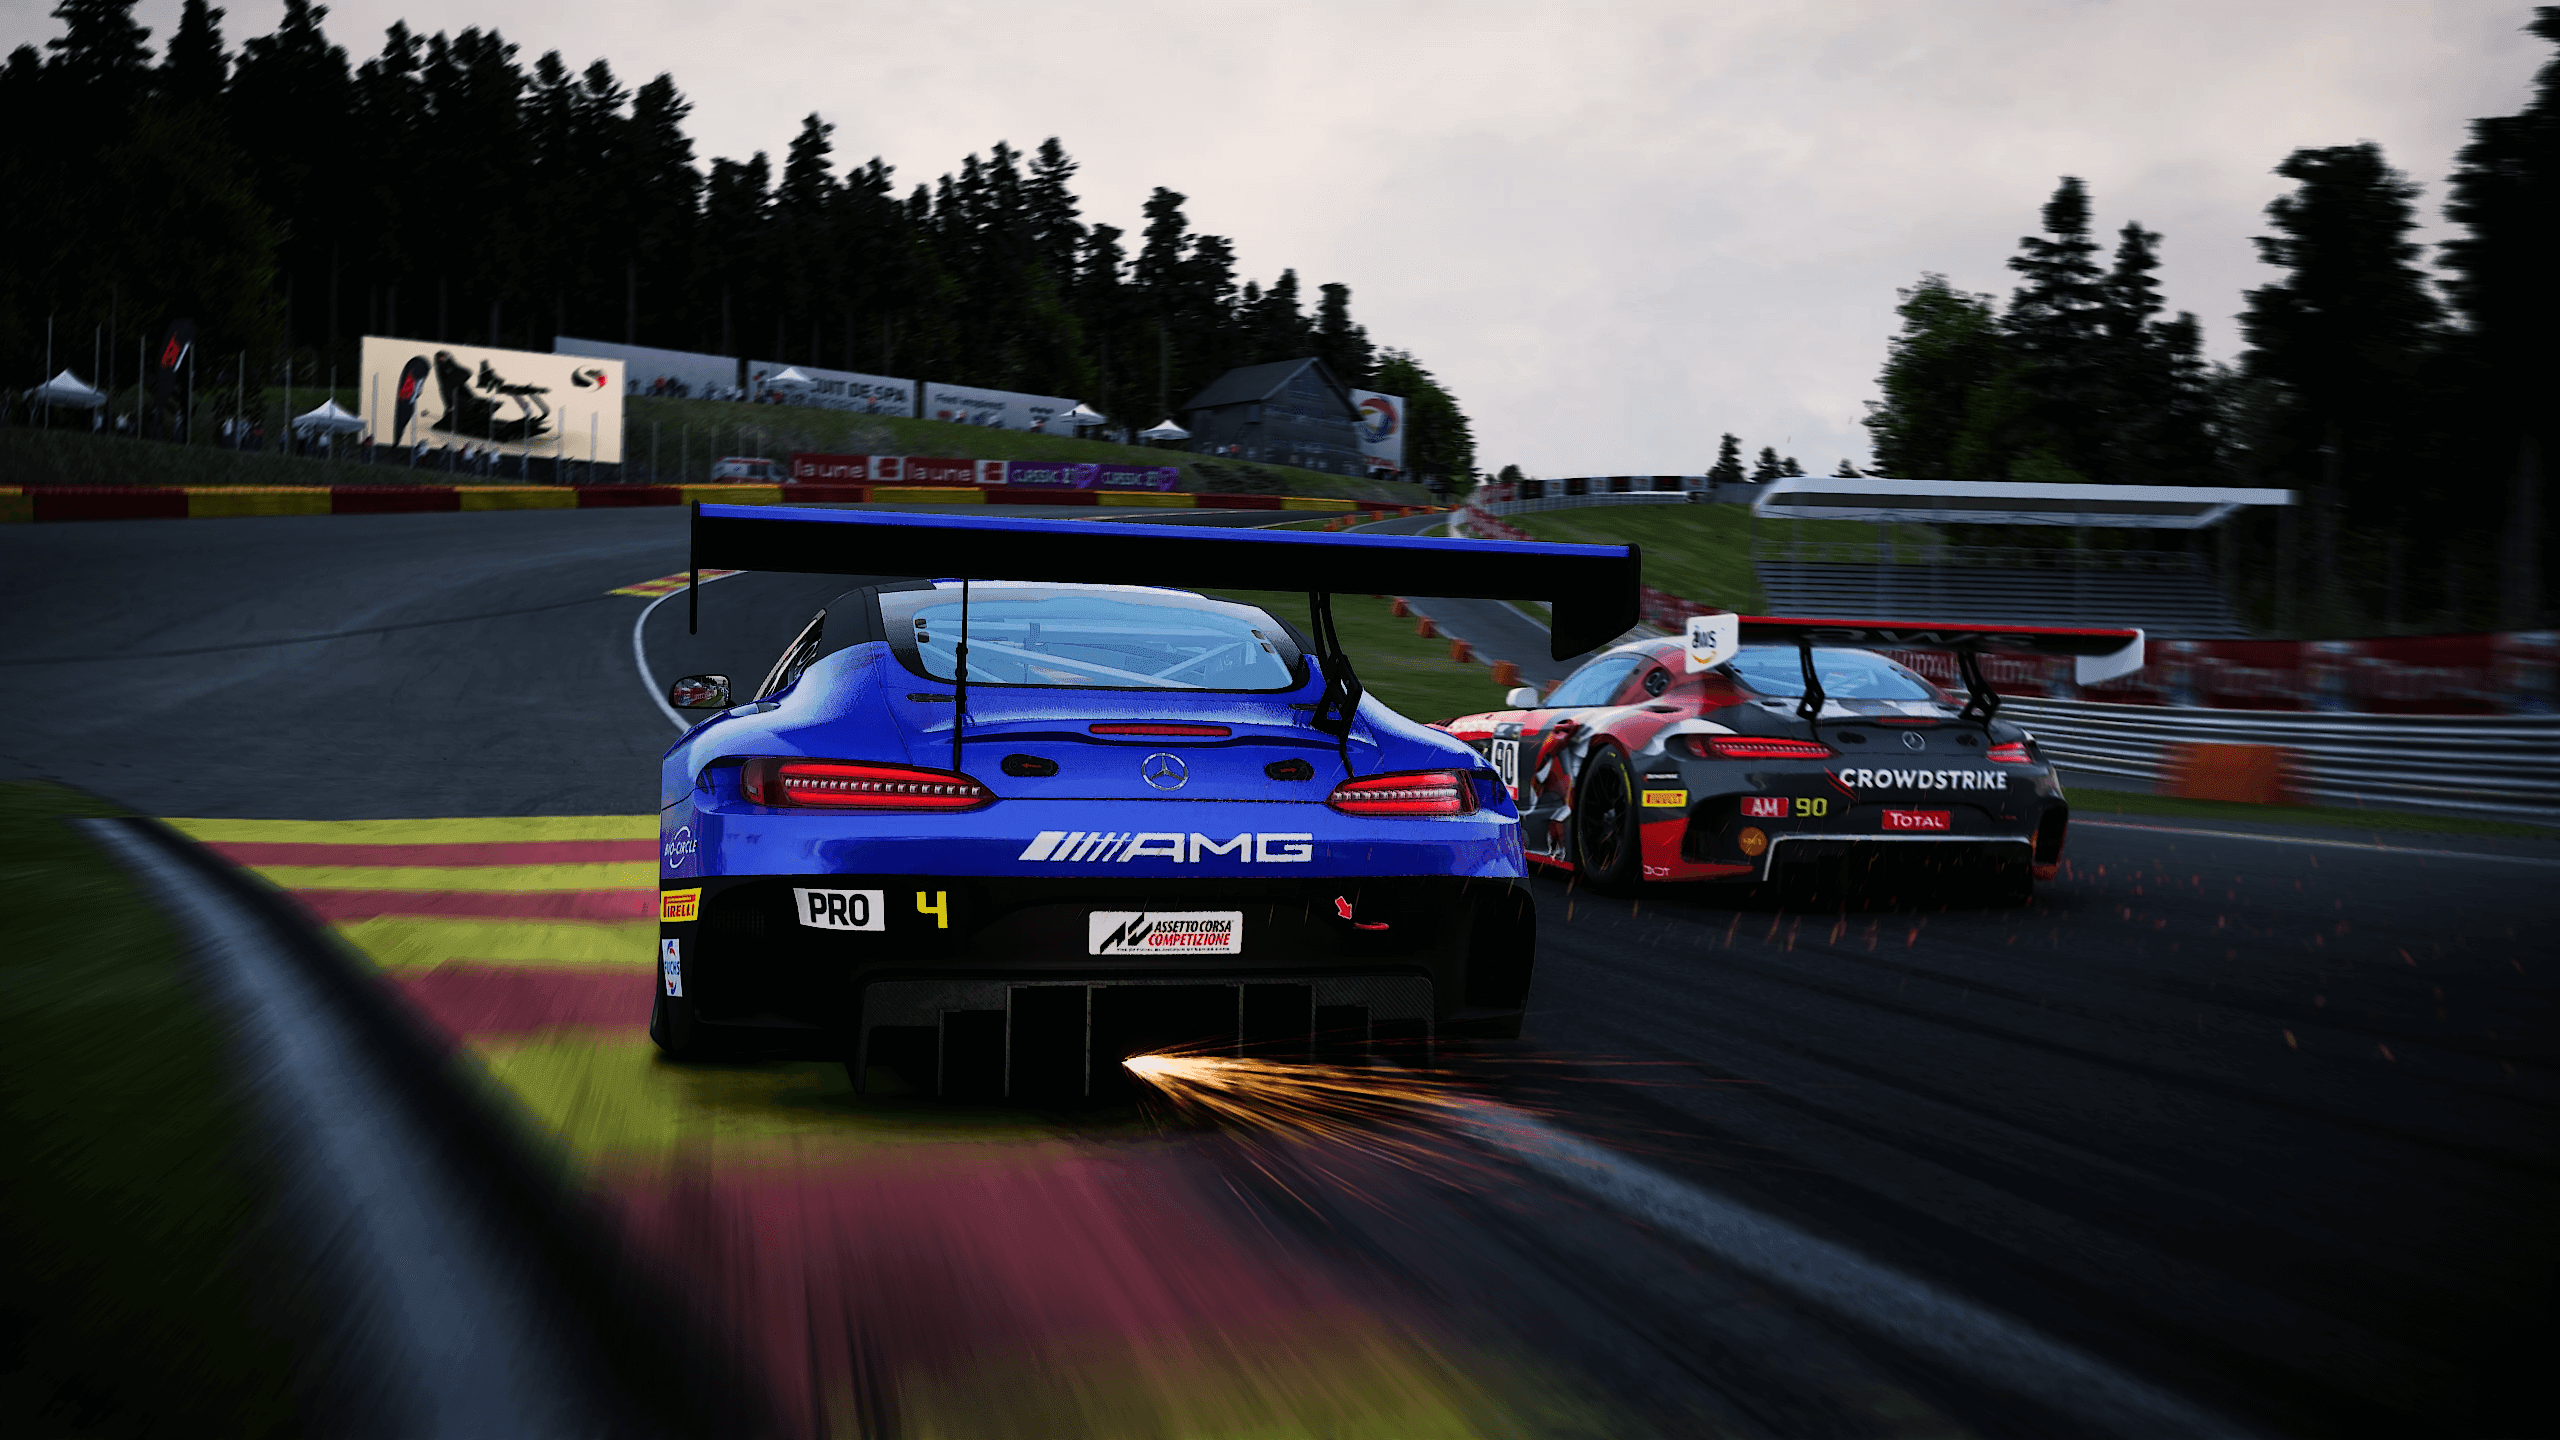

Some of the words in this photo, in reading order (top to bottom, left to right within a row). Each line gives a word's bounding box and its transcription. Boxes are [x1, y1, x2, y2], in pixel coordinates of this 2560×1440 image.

[810, 377, 846, 395] CUIT
[1496, 741, 1514, 785] 90
[1838, 767, 2008, 790] CROWDSTRIKE
[1751, 797, 1779, 815] AM
[1795, 797, 1828, 817] 90
[1890, 811, 1944, 828] TOTAL
[1116, 832, 1314, 863] AMG
[663, 893, 696, 919] PIRELLI
[807, 891, 870, 927] PRO
[916, 890, 949, 929] 4
[1154, 920, 1198, 933] ASSETTO
[1200, 920, 1232, 933] CORSA
[1148, 933, 1231, 947] COMPETIZIONE
[664, 960, 681, 976] FUCHS
